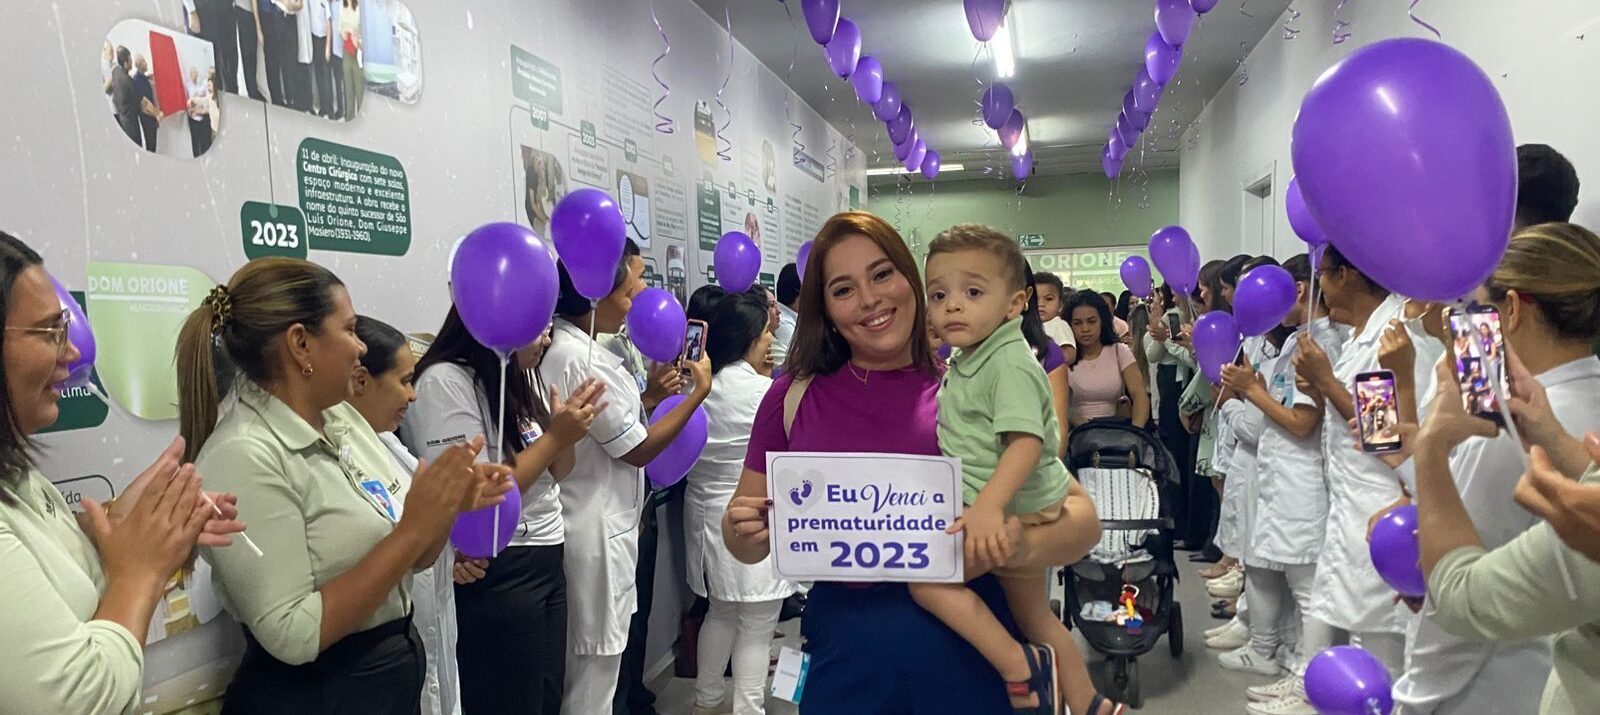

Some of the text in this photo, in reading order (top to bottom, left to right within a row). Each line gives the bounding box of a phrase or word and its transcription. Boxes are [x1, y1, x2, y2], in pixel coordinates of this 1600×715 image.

[302, 148, 309, 159] 11
[311, 150, 320, 161] de
[340, 156, 378, 174] Inauguração
[380, 166, 388, 176] do
[389, 168, 404, 178] novo
[303, 162, 327, 175] Centro
[328, 166, 358, 182] Cirúrgico
[360, 174, 373, 183] com
[374, 176, 386, 186] sete
[304, 176, 331, 190] espaço
[334, 180, 366, 194] moderno
[374, 189, 405, 201] excelente
[305, 186, 406, 212] infraestrutura. A obra recebe o
[306, 201, 406, 223] nome do quinto sucessor de São
[251, 220, 298, 248] 2023
[358, 219, 375, 230] Dom
[376, 222, 407, 235] Giuseppe
[88, 275, 189, 296] DOM ORIONE
[826, 483, 945, 514] Eu Venci a
[788, 514, 946, 532] prematuridade
[790, 541, 930, 569] em 2023
